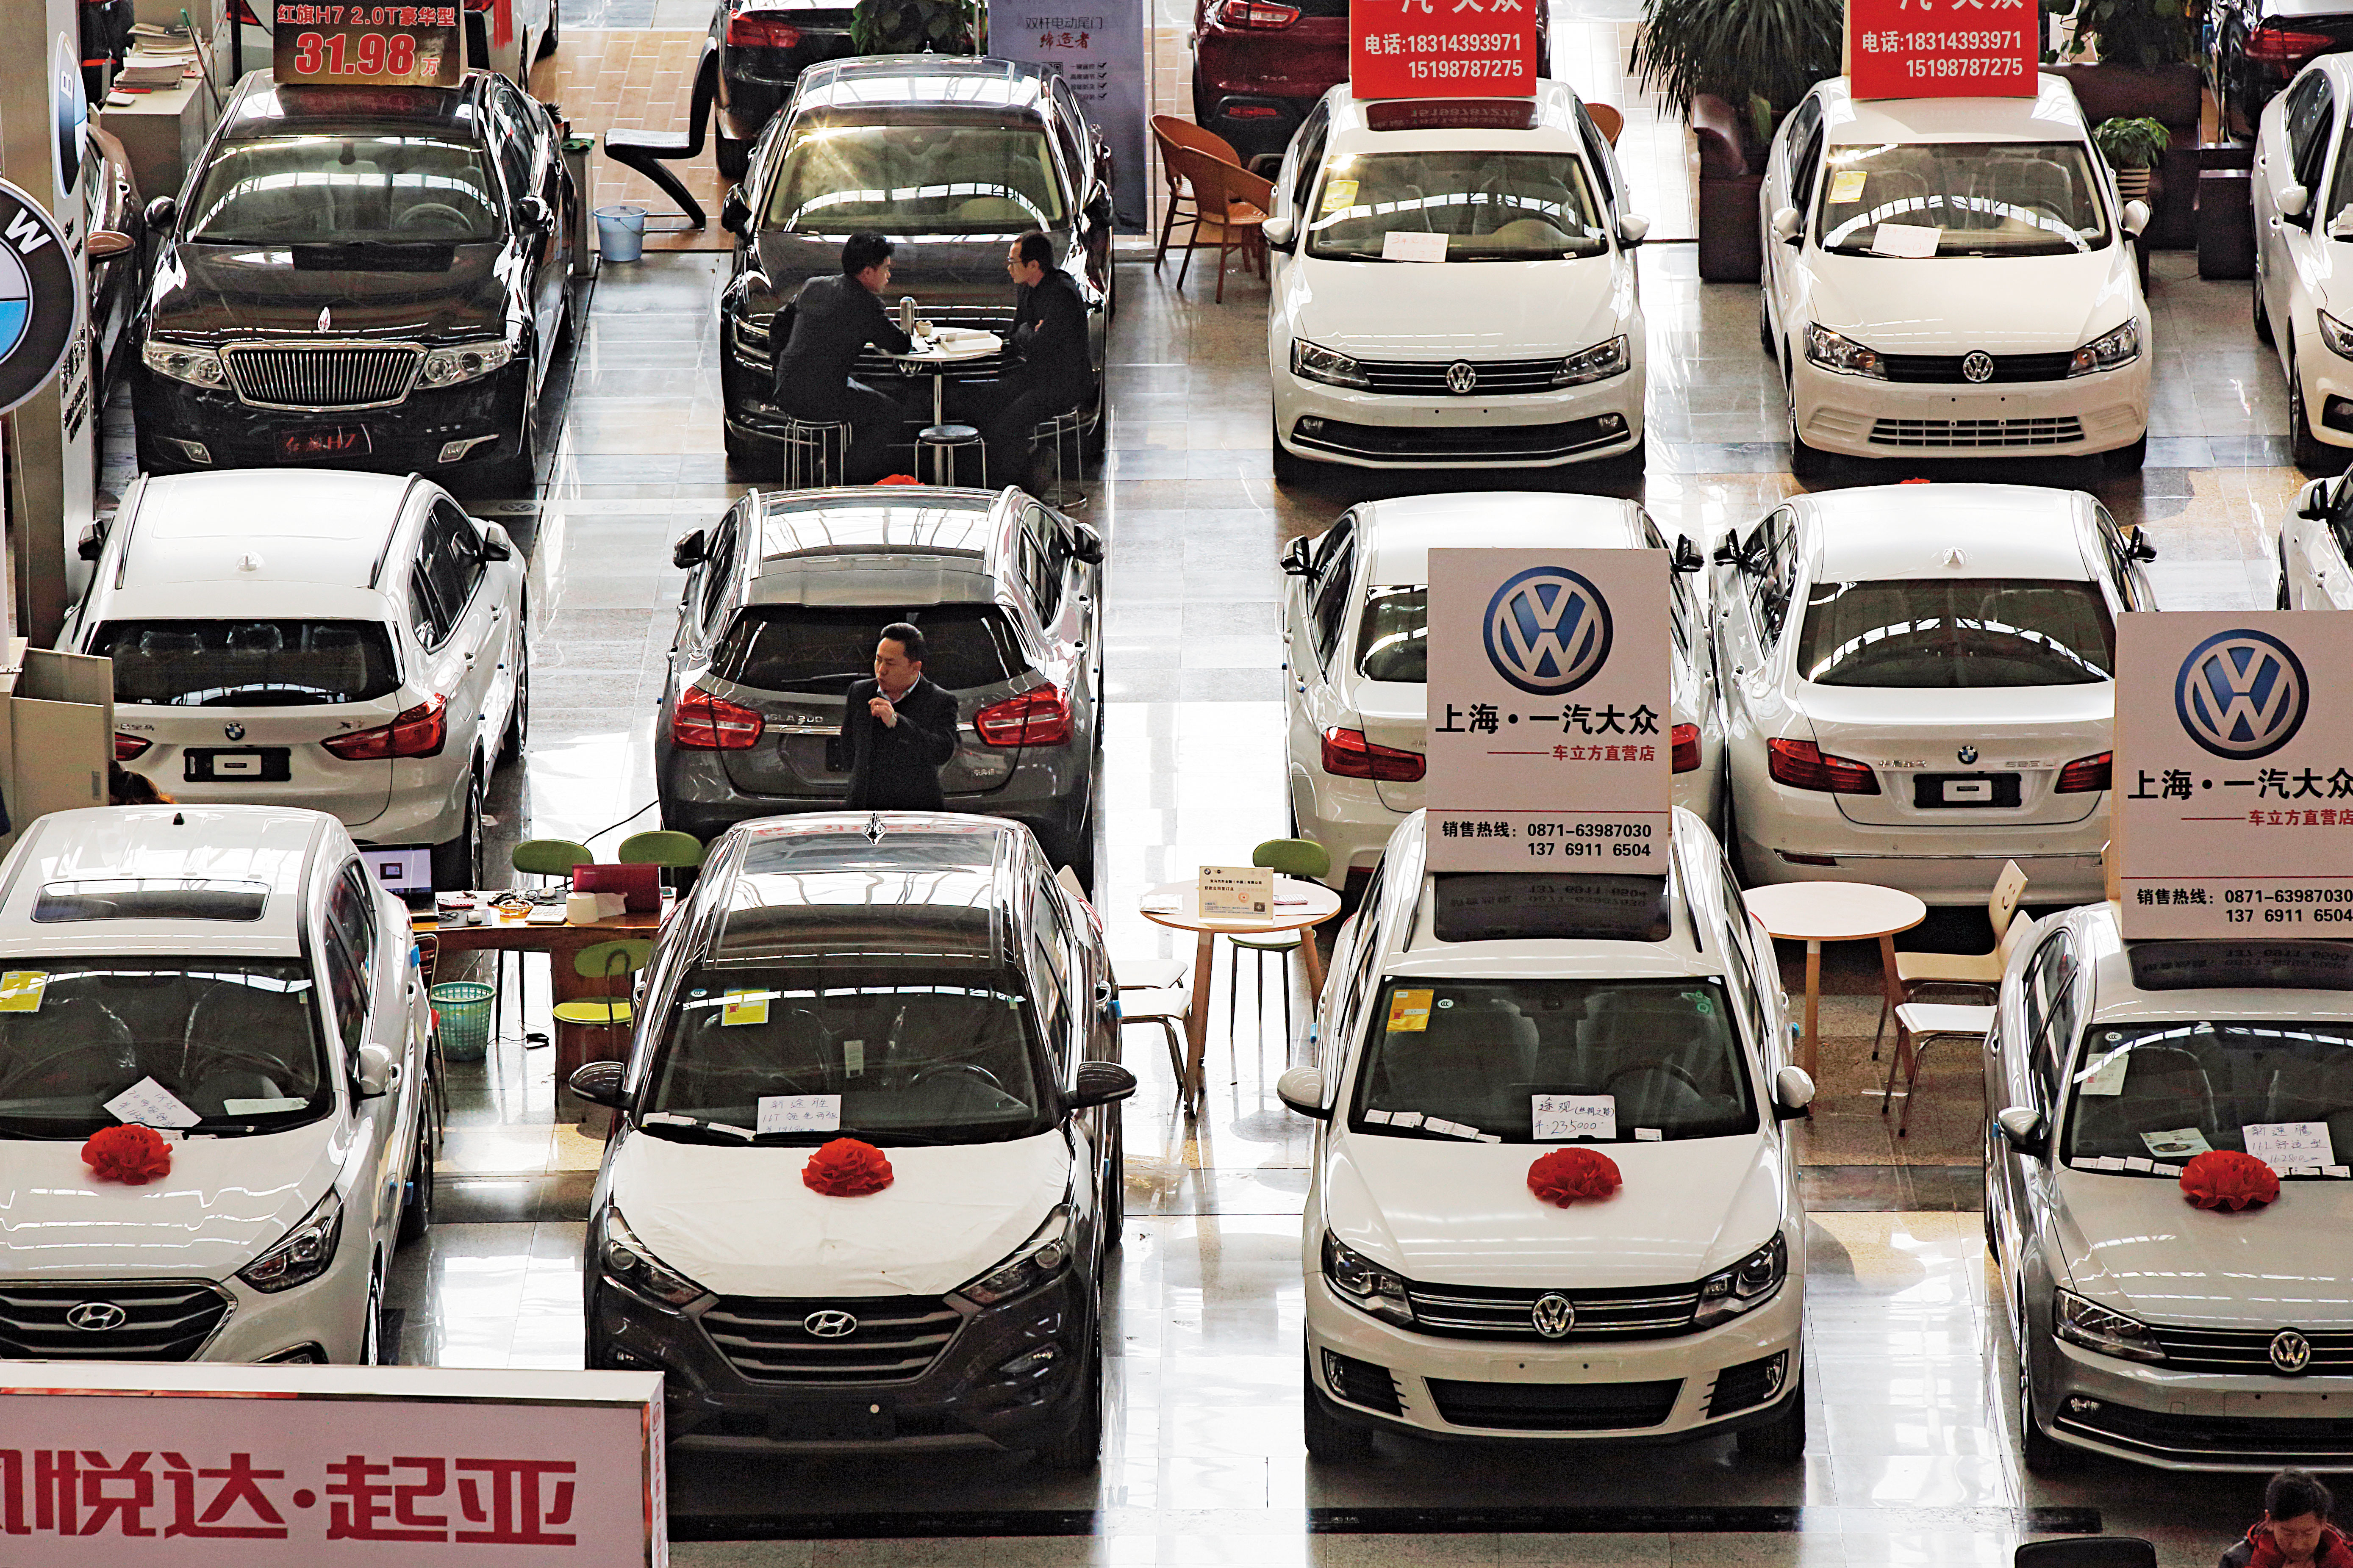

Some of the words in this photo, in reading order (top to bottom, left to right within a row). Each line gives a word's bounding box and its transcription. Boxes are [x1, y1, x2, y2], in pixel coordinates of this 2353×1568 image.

[1026, 17, 1103, 29] 双杆电动尾门
[295, 32, 416, 76] 31.98
[421, 57, 440, 77] 万
[1408, 60, 1523, 78] 15198787275
[1906, 58, 2023, 77] 15198787275
[1435, 703, 1659, 735] 上海·一汽大众
[1553, 745, 1655, 762] 车立方直营店
[1527, 823, 1652, 837] 0871-63987030
[1528, 843, 1555, 856] 137
[1565, 843, 1602, 856] 6911
[1612, 843, 1651, 856] 6504
[2225, 889, 2353, 903] 0871-63987030
[2226, 909, 2254, 922] 137
[2264, 909, 2303, 922] 6911
[2314, 909, 2353, 922] 6504
[0, 1449, 577, 1546] 悦达·起亚
